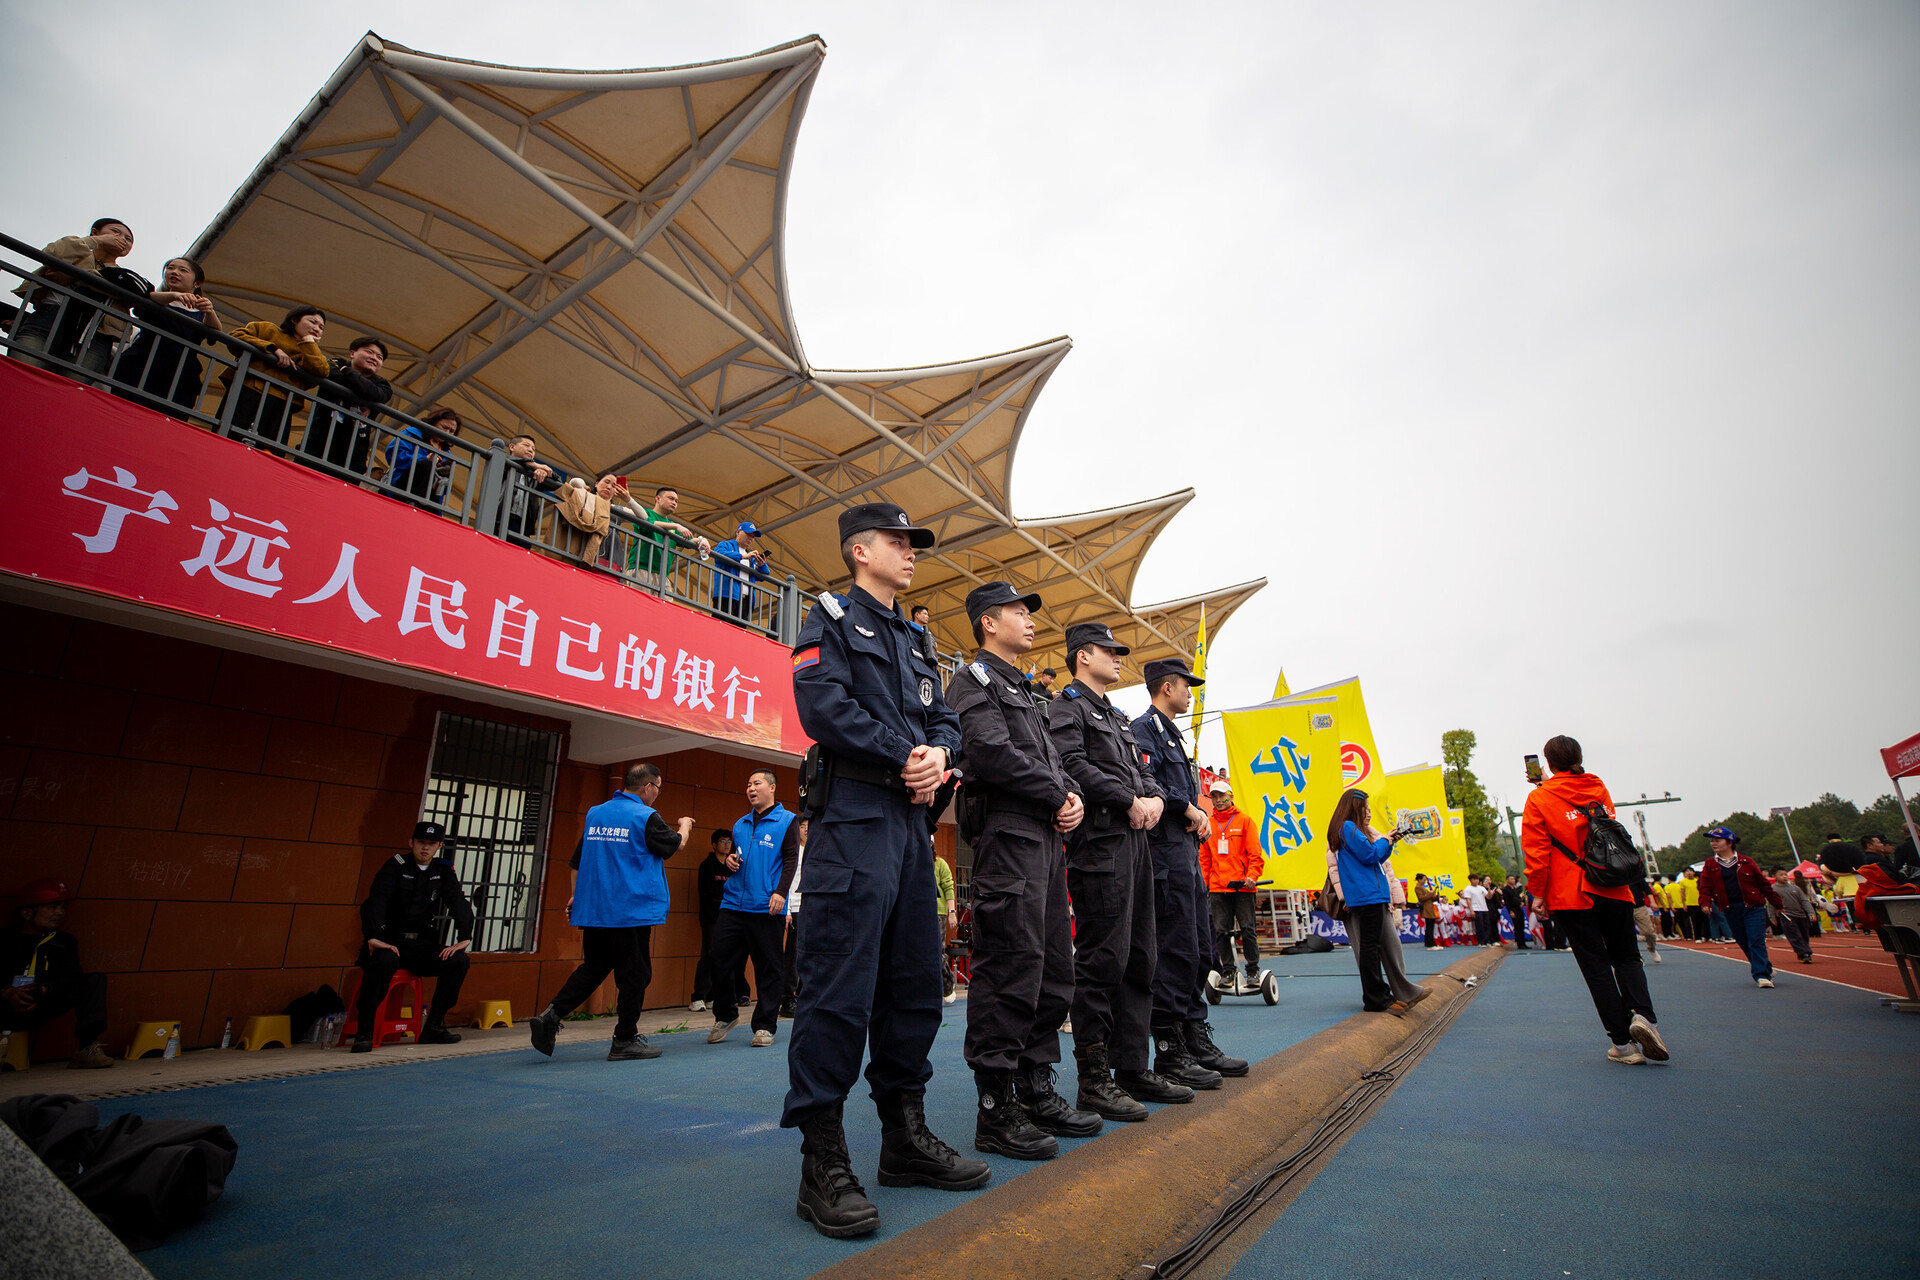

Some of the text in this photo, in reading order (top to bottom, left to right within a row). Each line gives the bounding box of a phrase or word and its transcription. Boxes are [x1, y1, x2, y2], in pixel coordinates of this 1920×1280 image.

[61, 465, 762, 724] 宁远人民自己的银行
[588, 826, 630, 838] 影人文化传媒
[1250, 735, 1315, 860] 宁远
